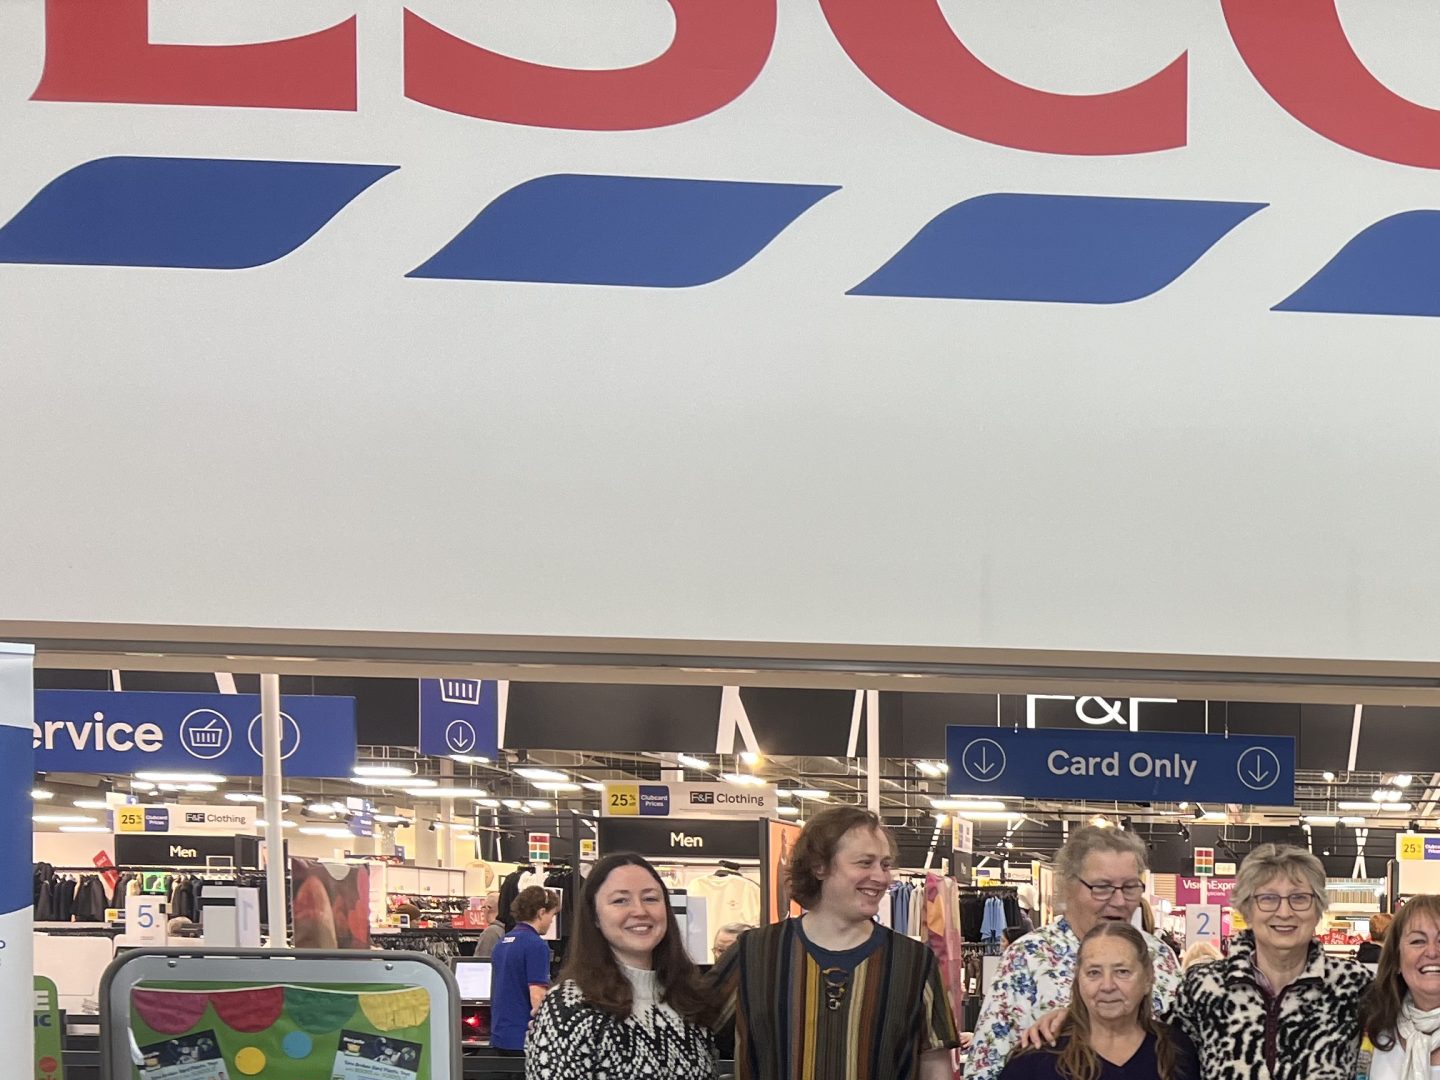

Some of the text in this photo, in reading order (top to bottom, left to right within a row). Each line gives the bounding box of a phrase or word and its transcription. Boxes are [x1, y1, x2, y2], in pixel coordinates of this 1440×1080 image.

[1047, 750, 1197, 785] Card Only
[690, 791, 764, 806] F&F Clothing
[207, 814, 246, 824] Clothing
[670, 832, 703, 848] Men
[170, 845, 197, 858] Men
[138, 905, 153, 928] 5
